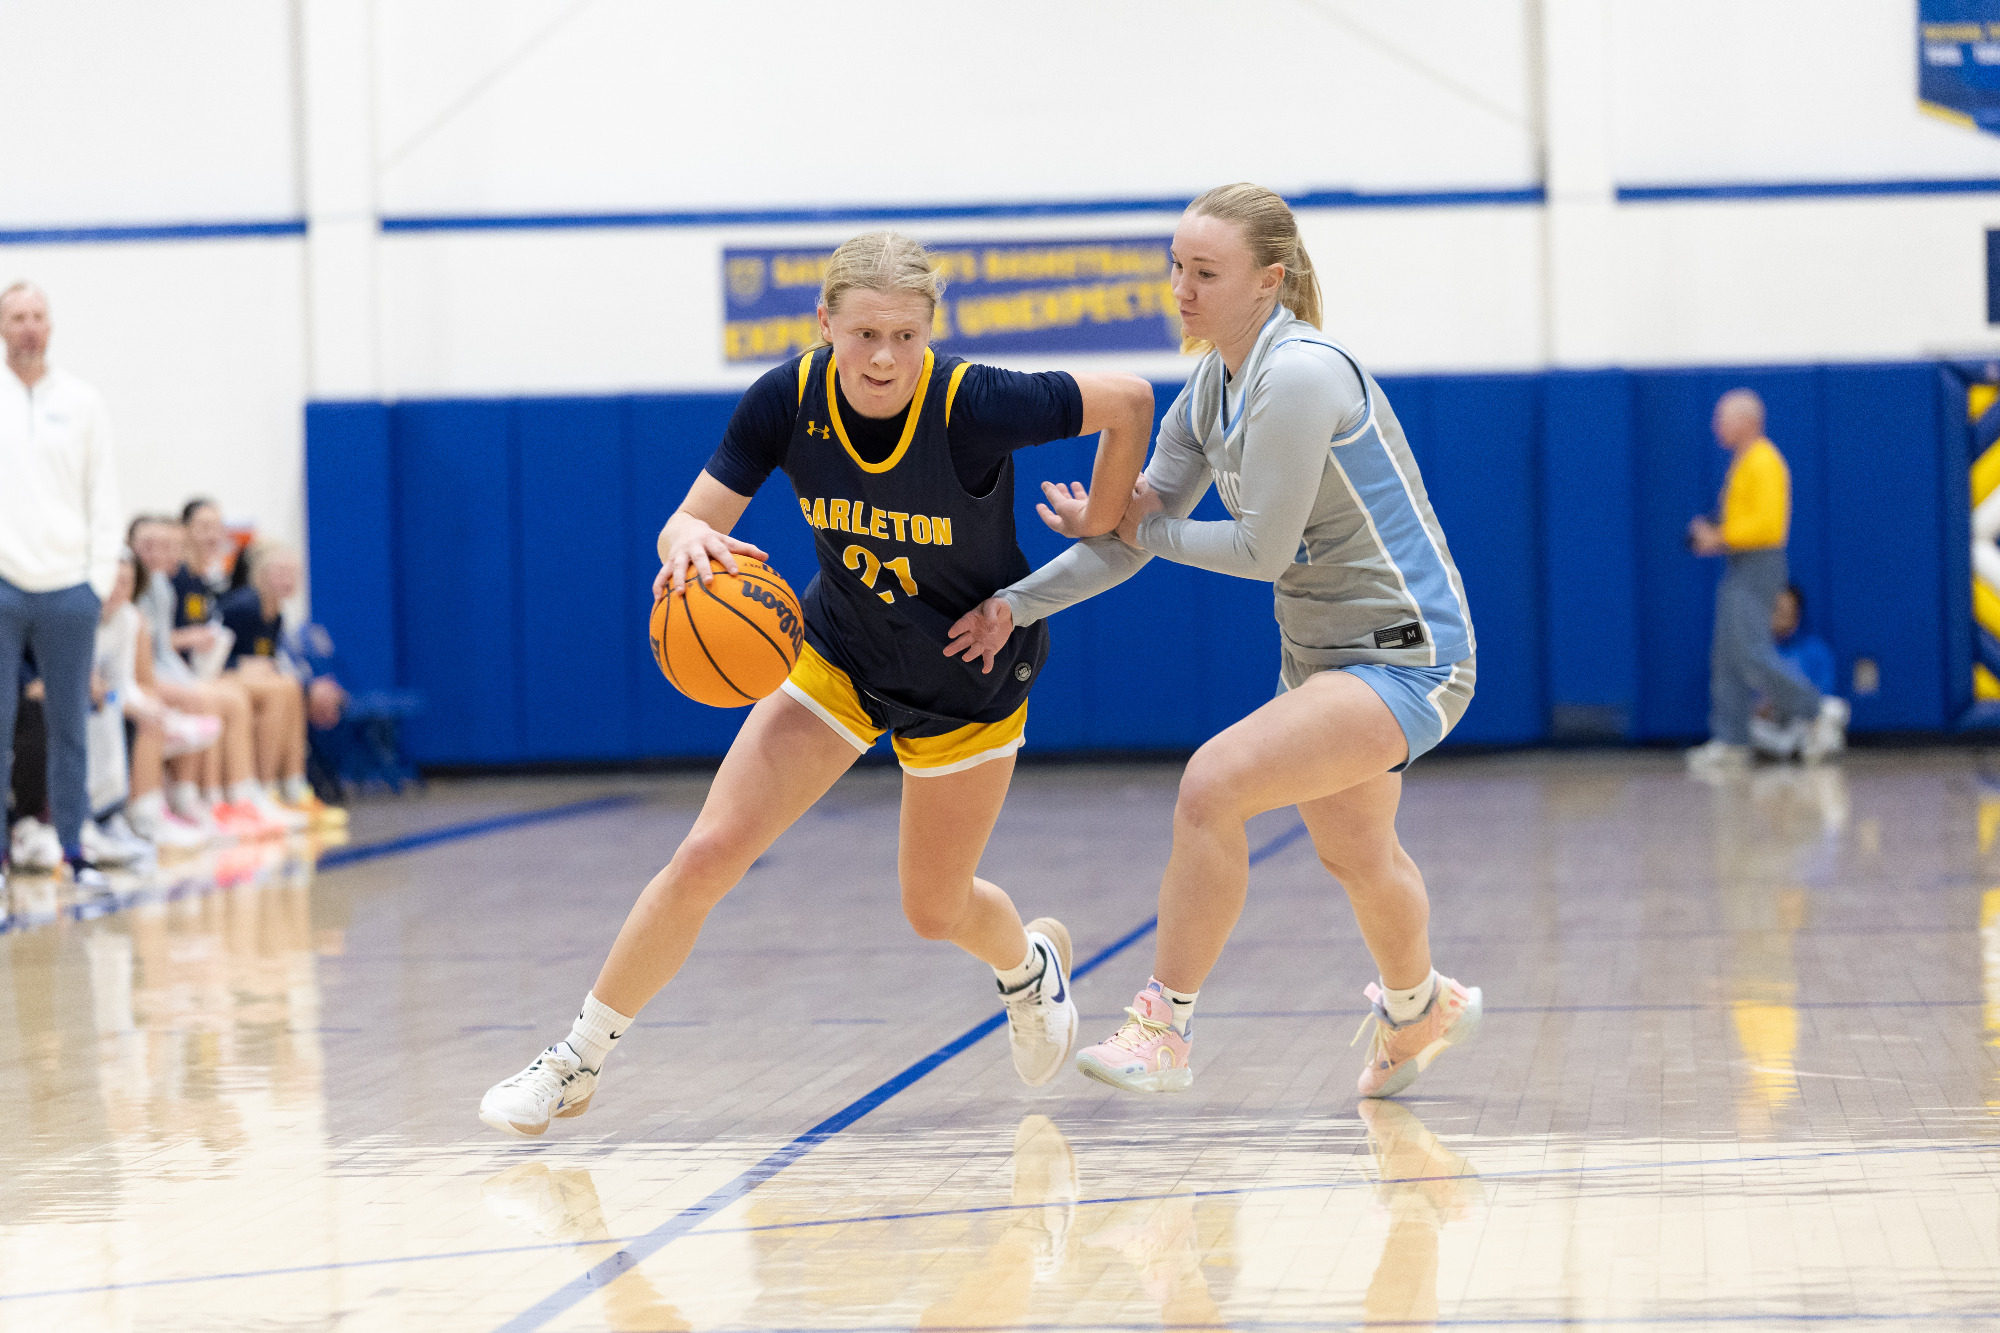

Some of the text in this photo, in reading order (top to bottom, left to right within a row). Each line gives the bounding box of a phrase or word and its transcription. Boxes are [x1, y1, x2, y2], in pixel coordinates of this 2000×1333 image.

[800, 497, 953, 546] CARLETON
[843, 544, 919, 604] 21
[1406, 629, 1416, 640] M
